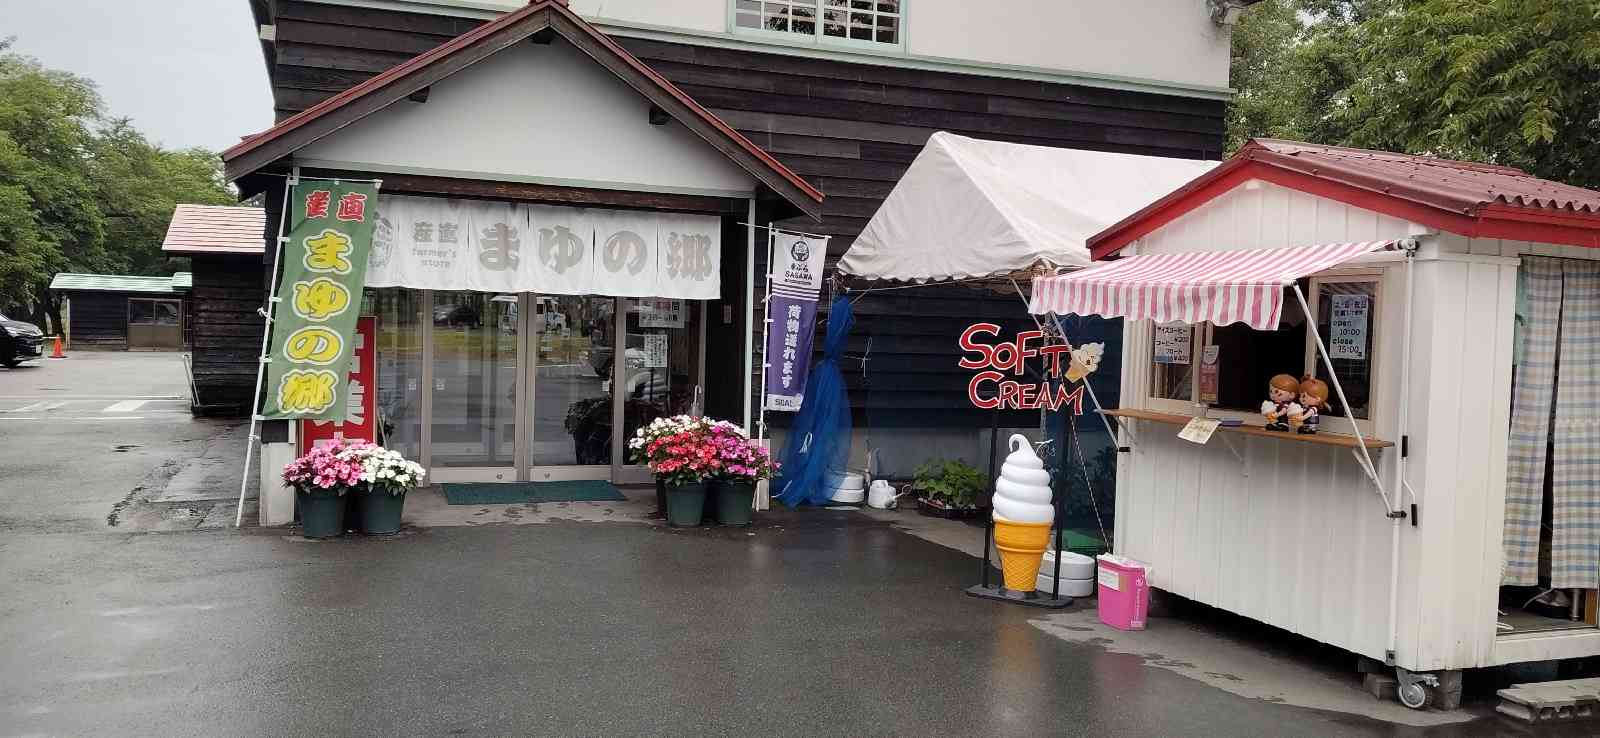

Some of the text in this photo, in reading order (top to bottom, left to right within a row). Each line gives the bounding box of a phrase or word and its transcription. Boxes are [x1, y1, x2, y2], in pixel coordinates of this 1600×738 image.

[480, 222, 713, 281] まゆの郷
[784, 270, 813, 281] SAGAWA
[277, 229, 354, 414] まゆの郷
[1340, 328, 1361, 336] 10:00
[968, 370, 1085, 416] CREAM
